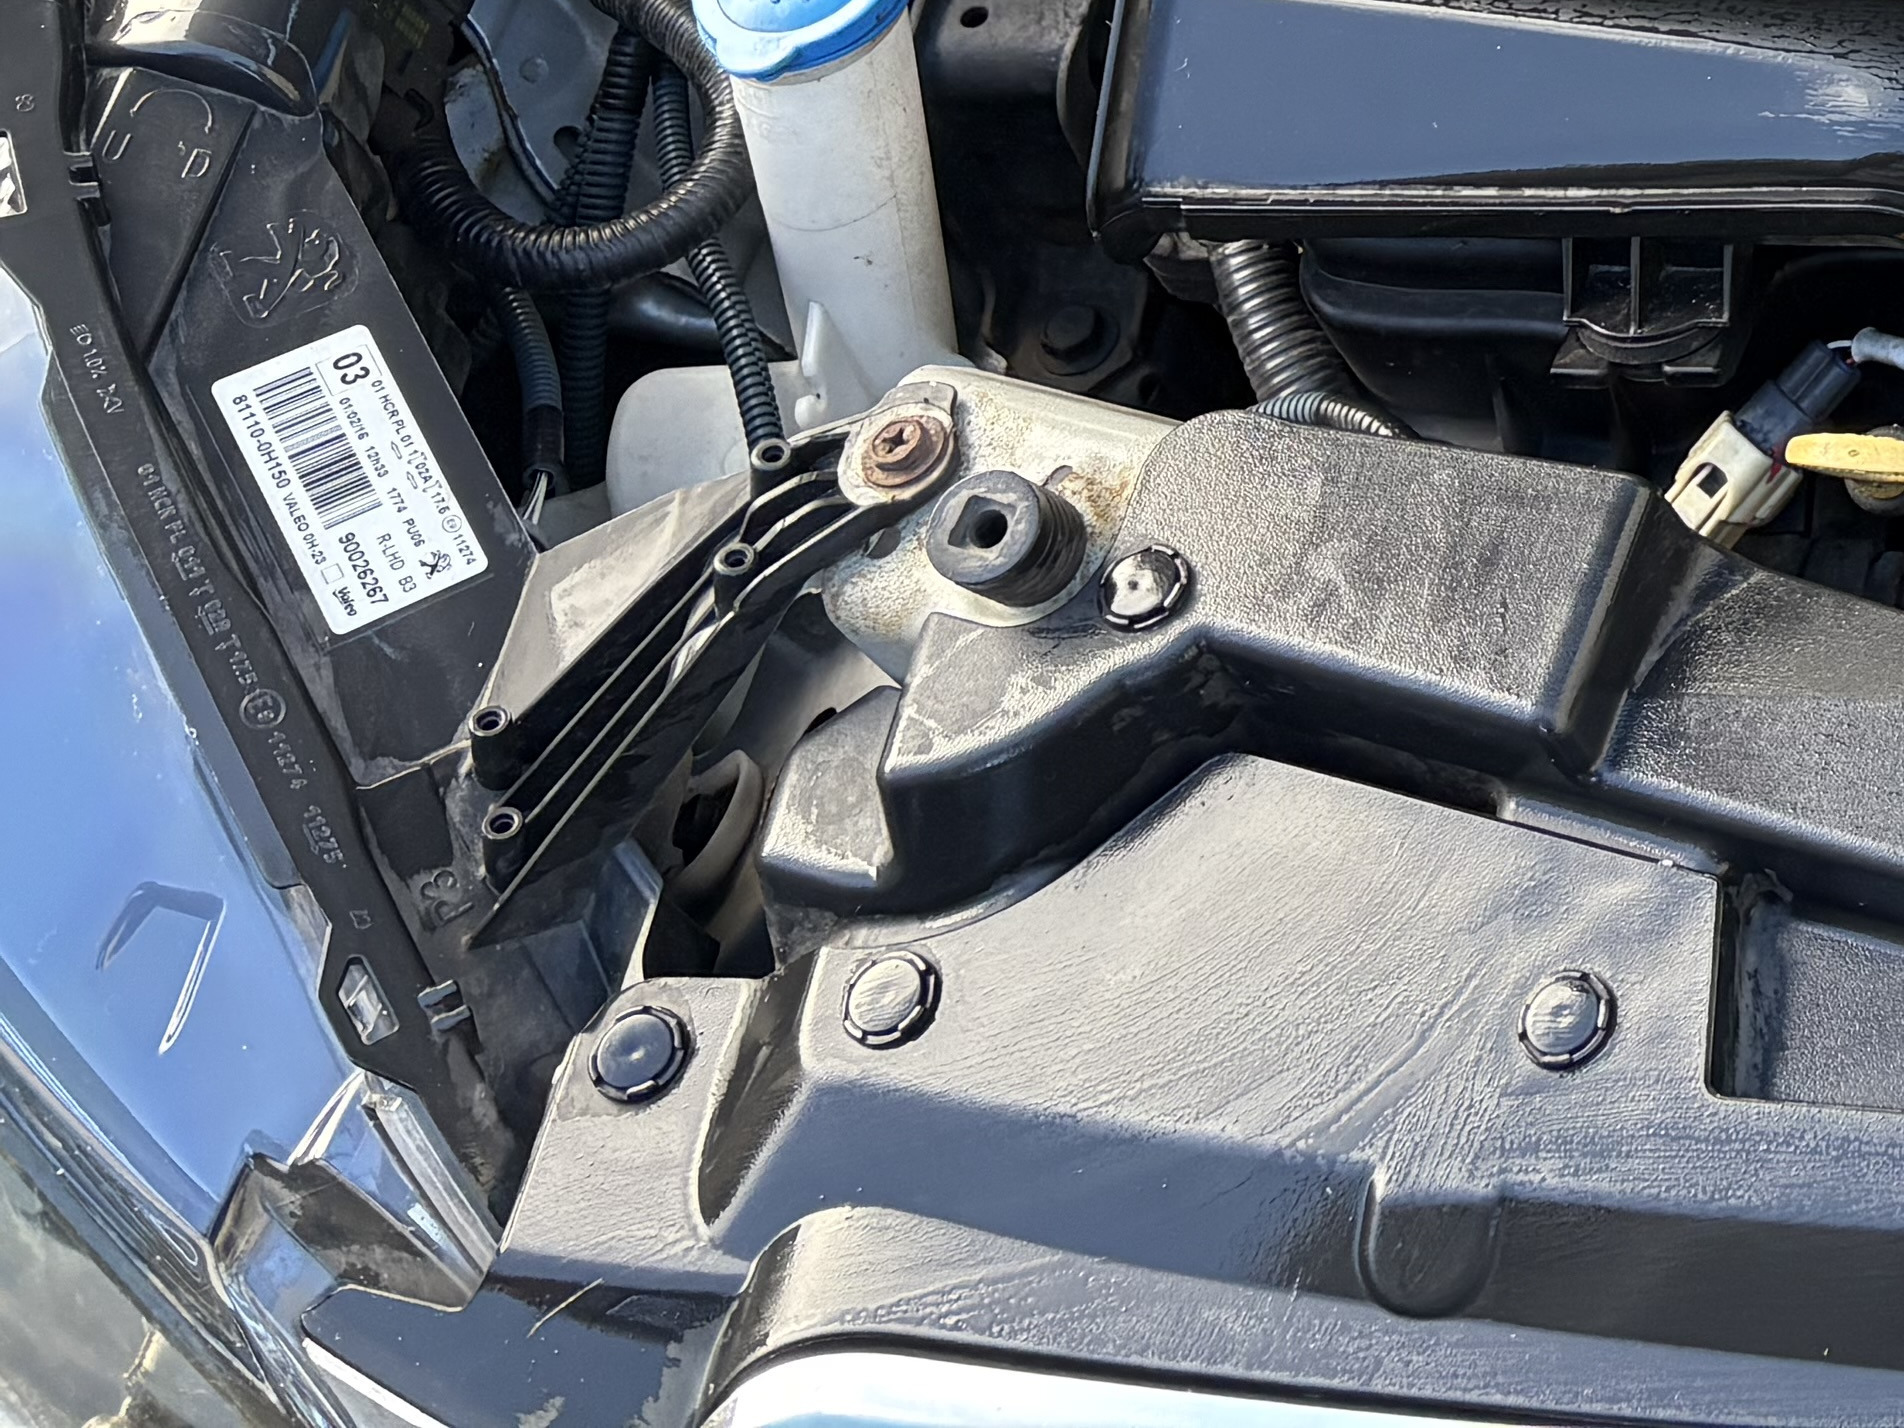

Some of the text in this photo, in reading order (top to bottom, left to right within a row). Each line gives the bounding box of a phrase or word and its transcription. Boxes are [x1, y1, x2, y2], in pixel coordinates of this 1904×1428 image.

[332, 352, 371, 386] 03
[232, 394, 291, 489] 81110-0H150
[282, 491, 310, 532] VALEO
[370, 379, 386, 393] 01
[378, 394, 400, 420] HCR
[391, 419, 406, 435] PL
[453, 533, 477, 566] 11274
[338, 532, 389, 604] 90026267
[376, 532, 417, 593] R-LHD B3
